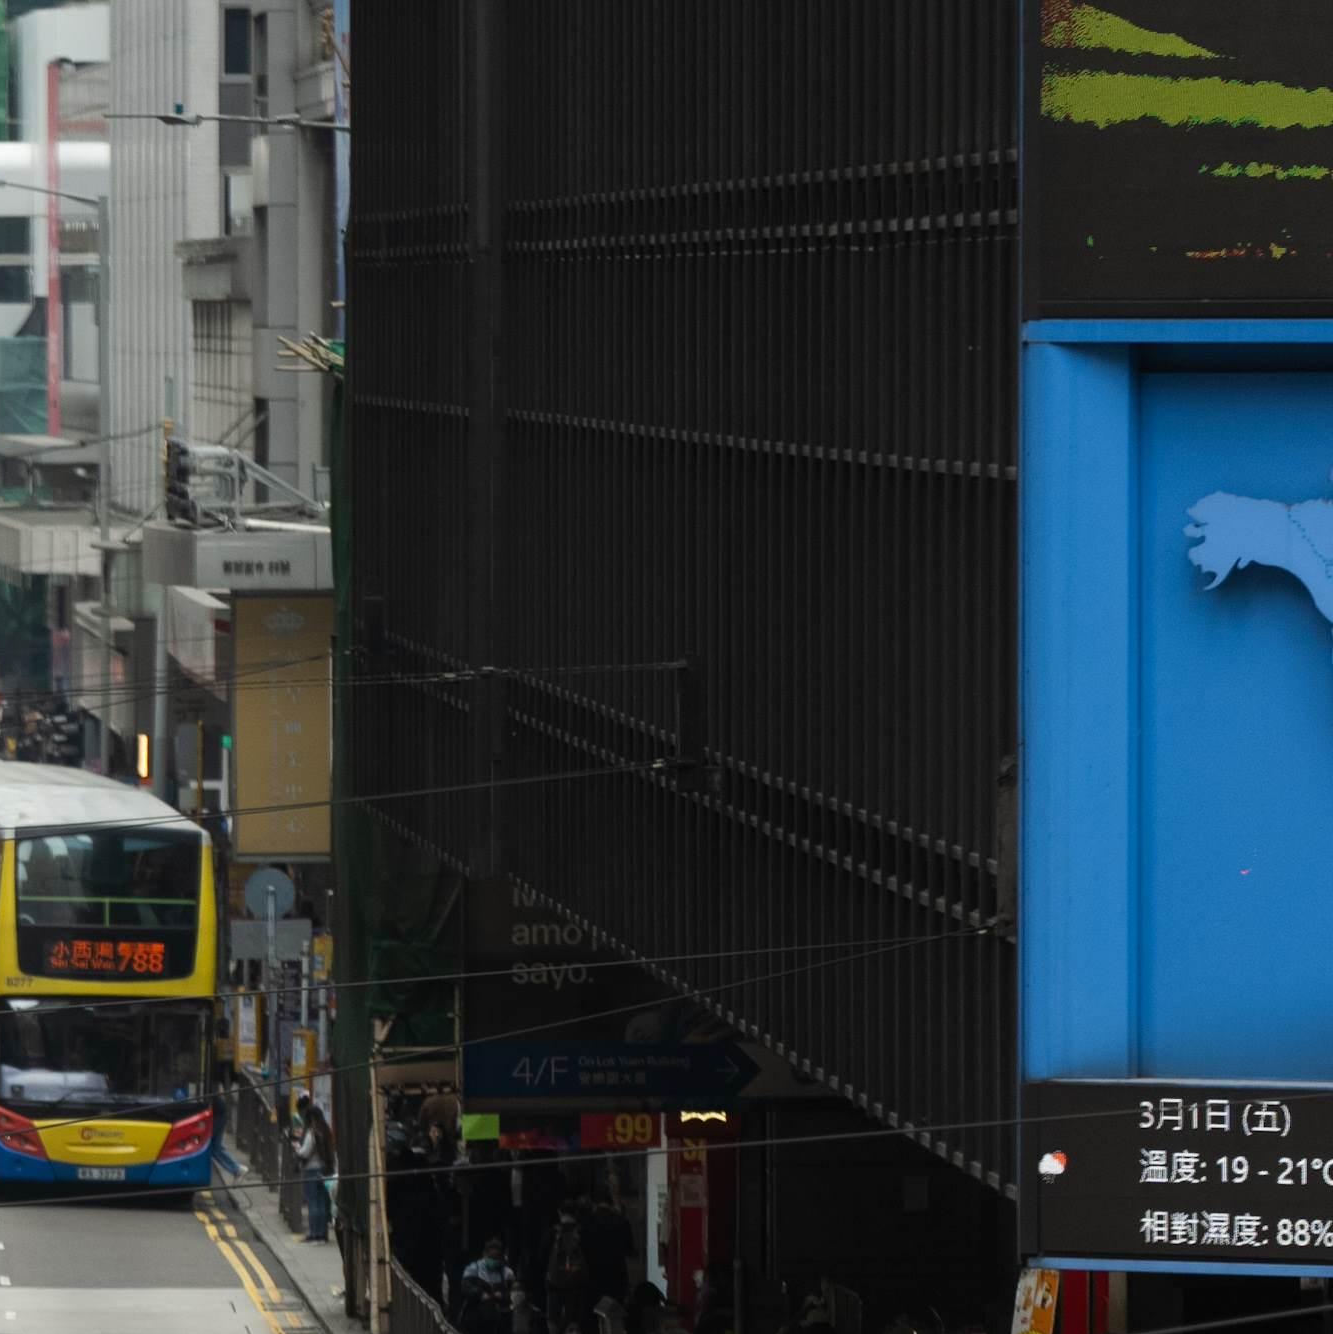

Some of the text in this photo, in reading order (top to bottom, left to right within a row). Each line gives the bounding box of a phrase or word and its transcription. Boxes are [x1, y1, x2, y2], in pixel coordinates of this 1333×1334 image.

[511, 1056, 570, 1088] 4/F
[1139, 1097, 1292, 1138] 3月1日 (五)
